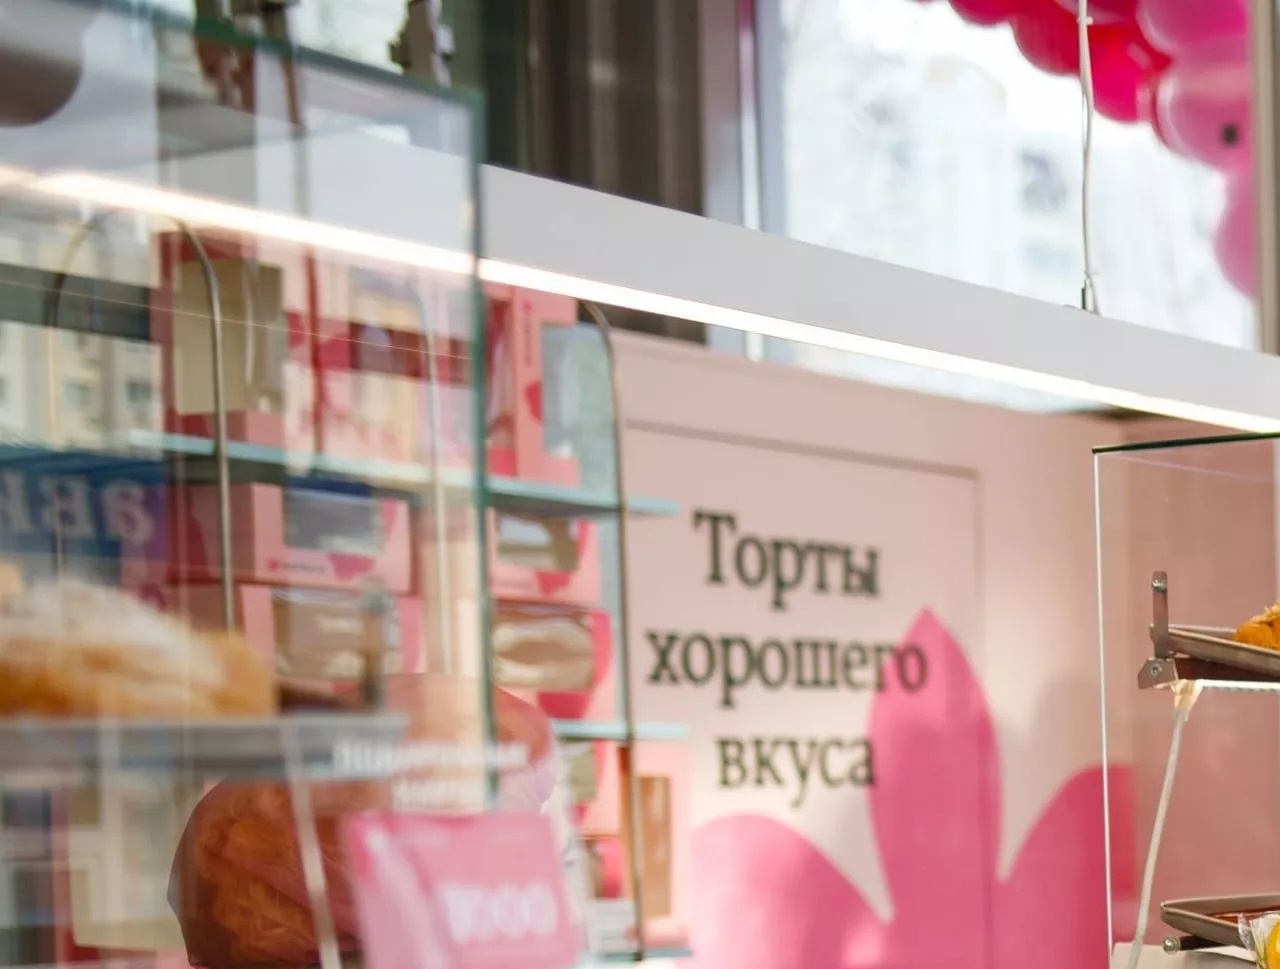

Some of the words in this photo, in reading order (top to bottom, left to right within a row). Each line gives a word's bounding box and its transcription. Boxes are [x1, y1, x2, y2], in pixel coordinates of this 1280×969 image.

[691, 508, 881, 611] Торты
[645, 629, 930, 709] хорошего
[715, 734, 877, 810] вкуса
